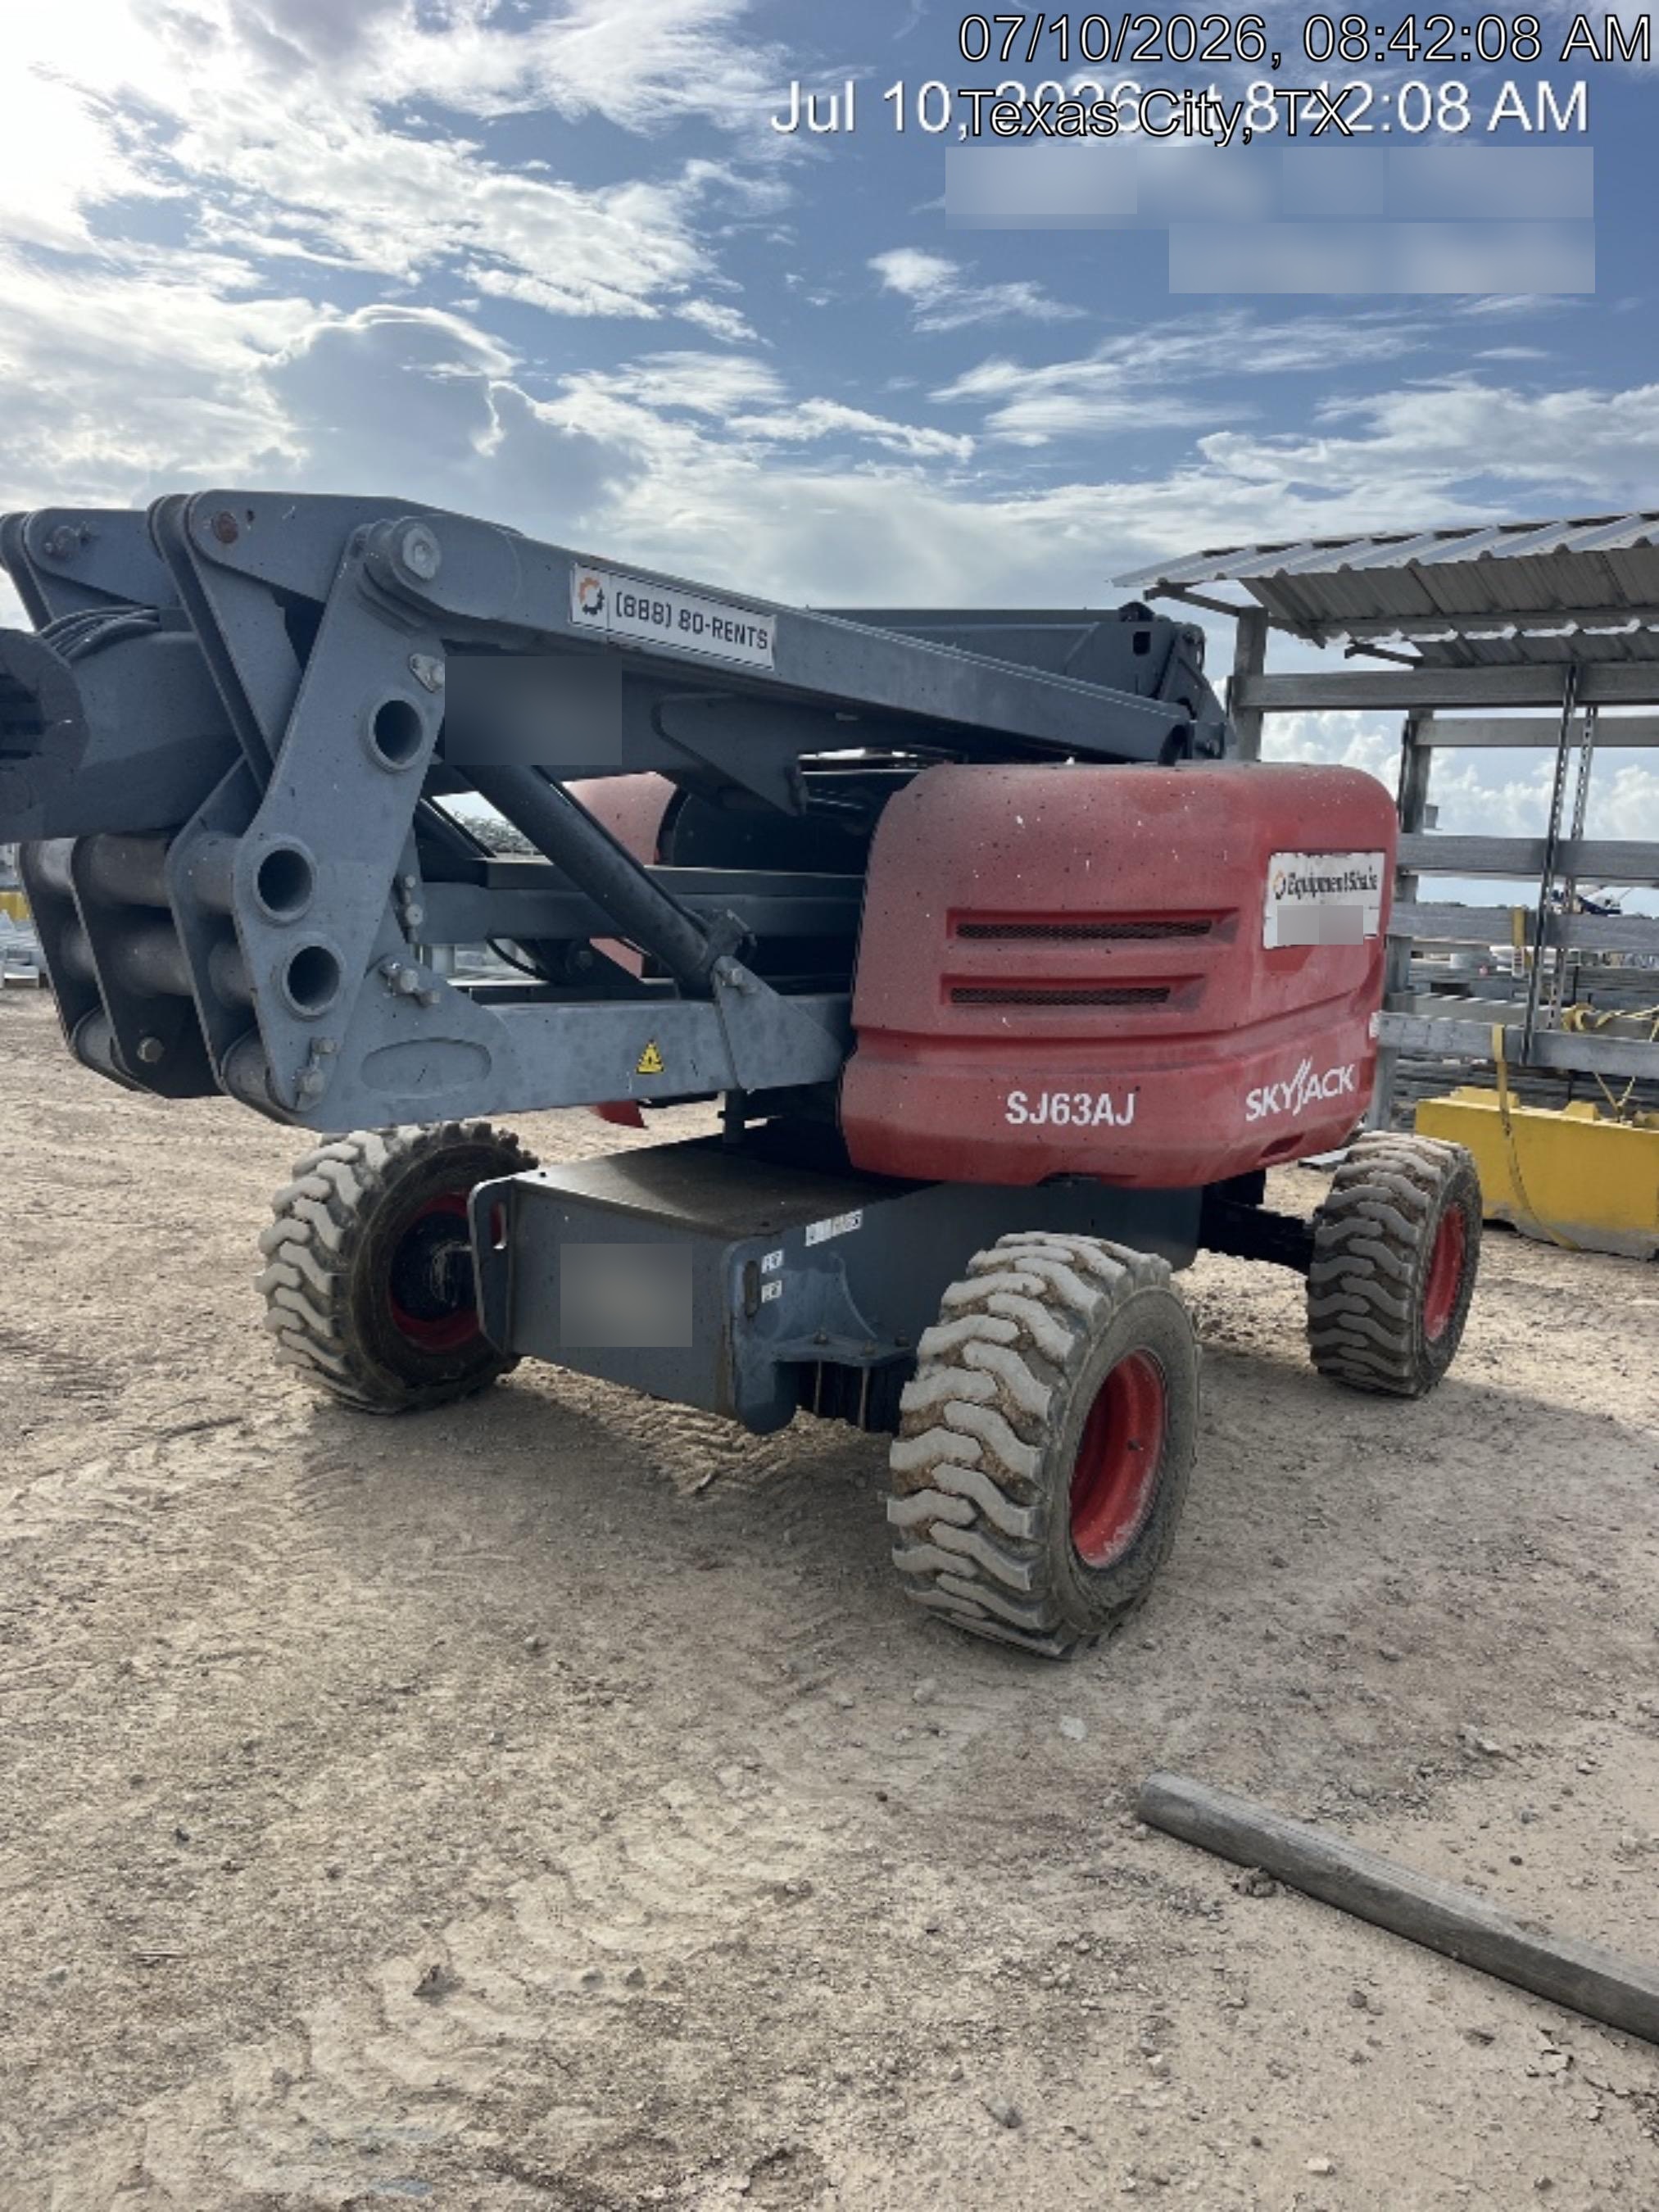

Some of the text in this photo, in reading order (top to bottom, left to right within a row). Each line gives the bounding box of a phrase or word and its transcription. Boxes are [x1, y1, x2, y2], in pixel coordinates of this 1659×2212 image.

[615, 592, 768, 650] (888) 80-RENTS
[1287, 867, 1378, 900] EquipmentSe
[1004, 1090, 1135, 1126] SJ63AJ
[1245, 1057, 1356, 1122] SKYJACK
